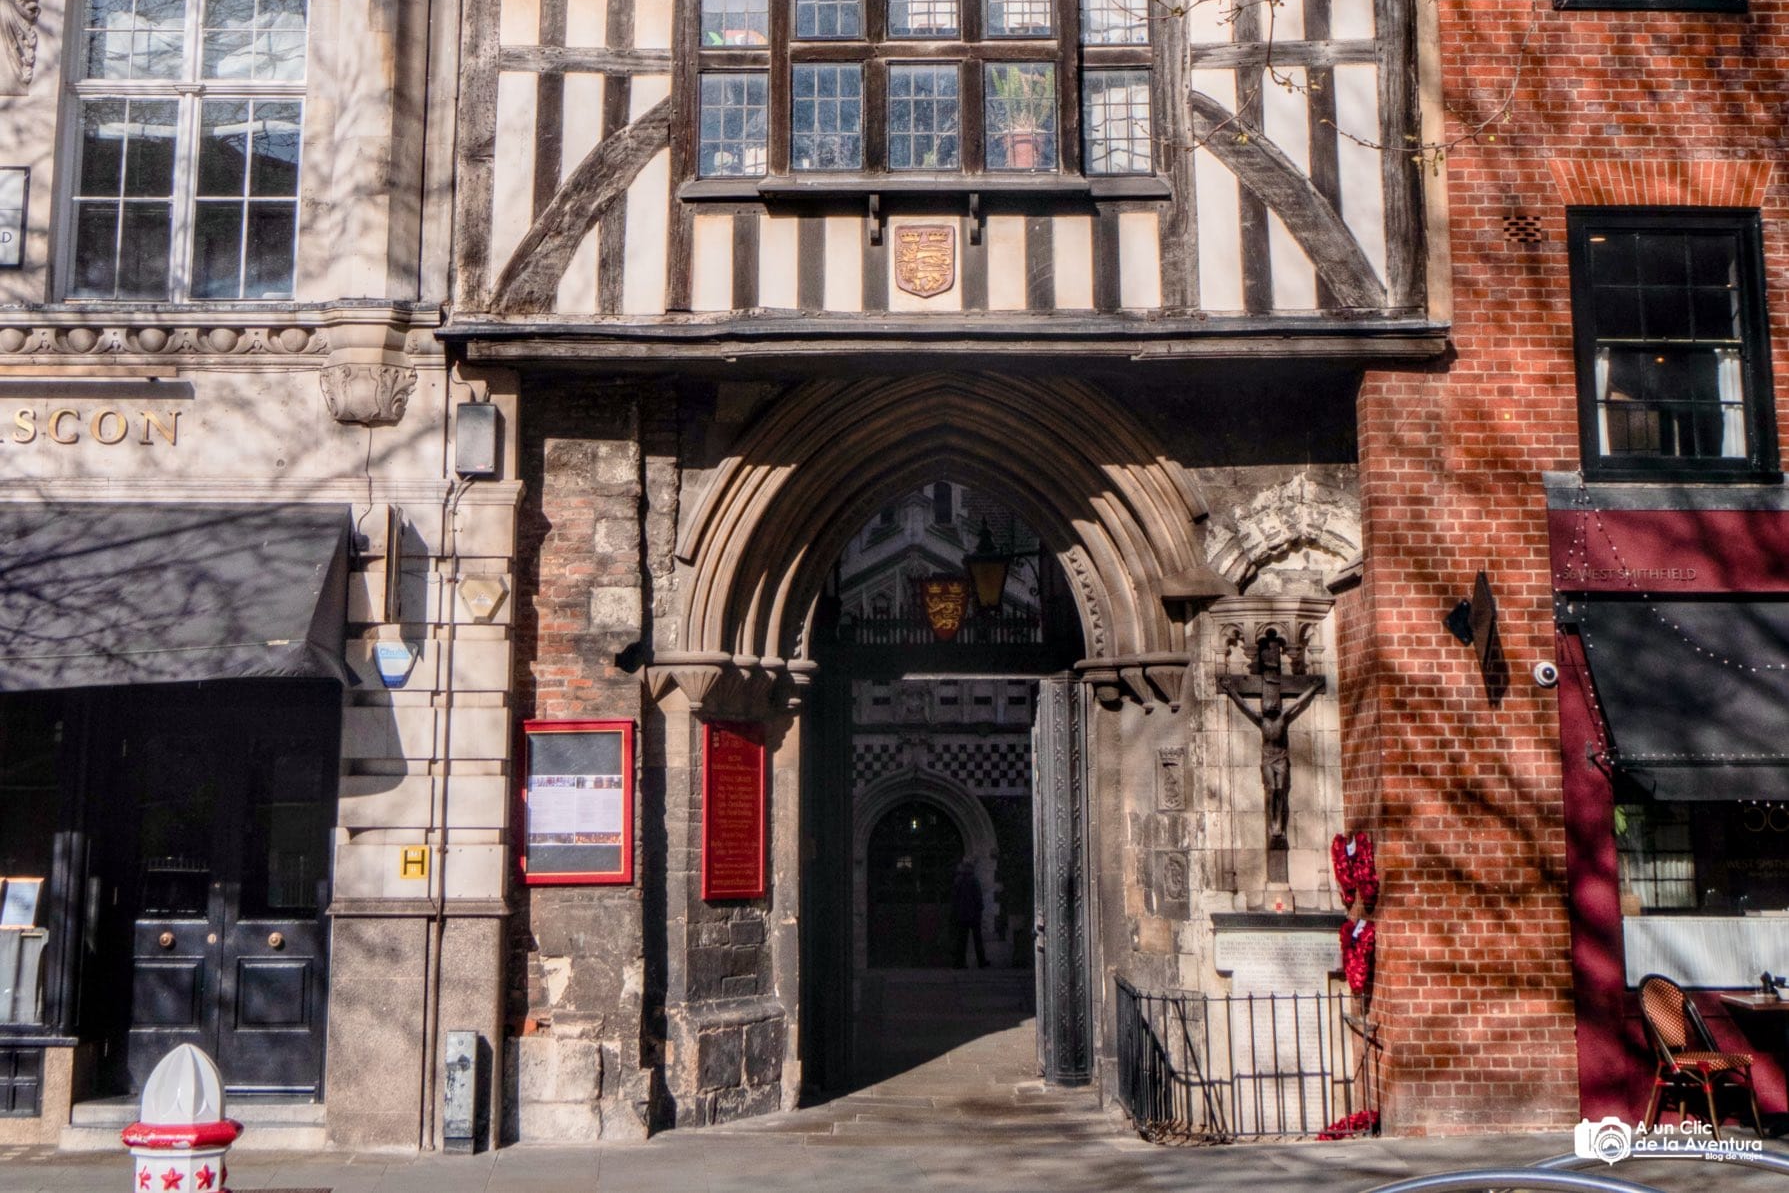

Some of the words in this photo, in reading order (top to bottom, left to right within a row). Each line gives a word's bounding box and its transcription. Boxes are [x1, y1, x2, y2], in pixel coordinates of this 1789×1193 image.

[0, 407, 182, 446] SCON
[1577, 567, 1614, 581] WEST
[1617, 567, 1697, 581] SMITHFIELD
[403, 849, 425, 875] H
